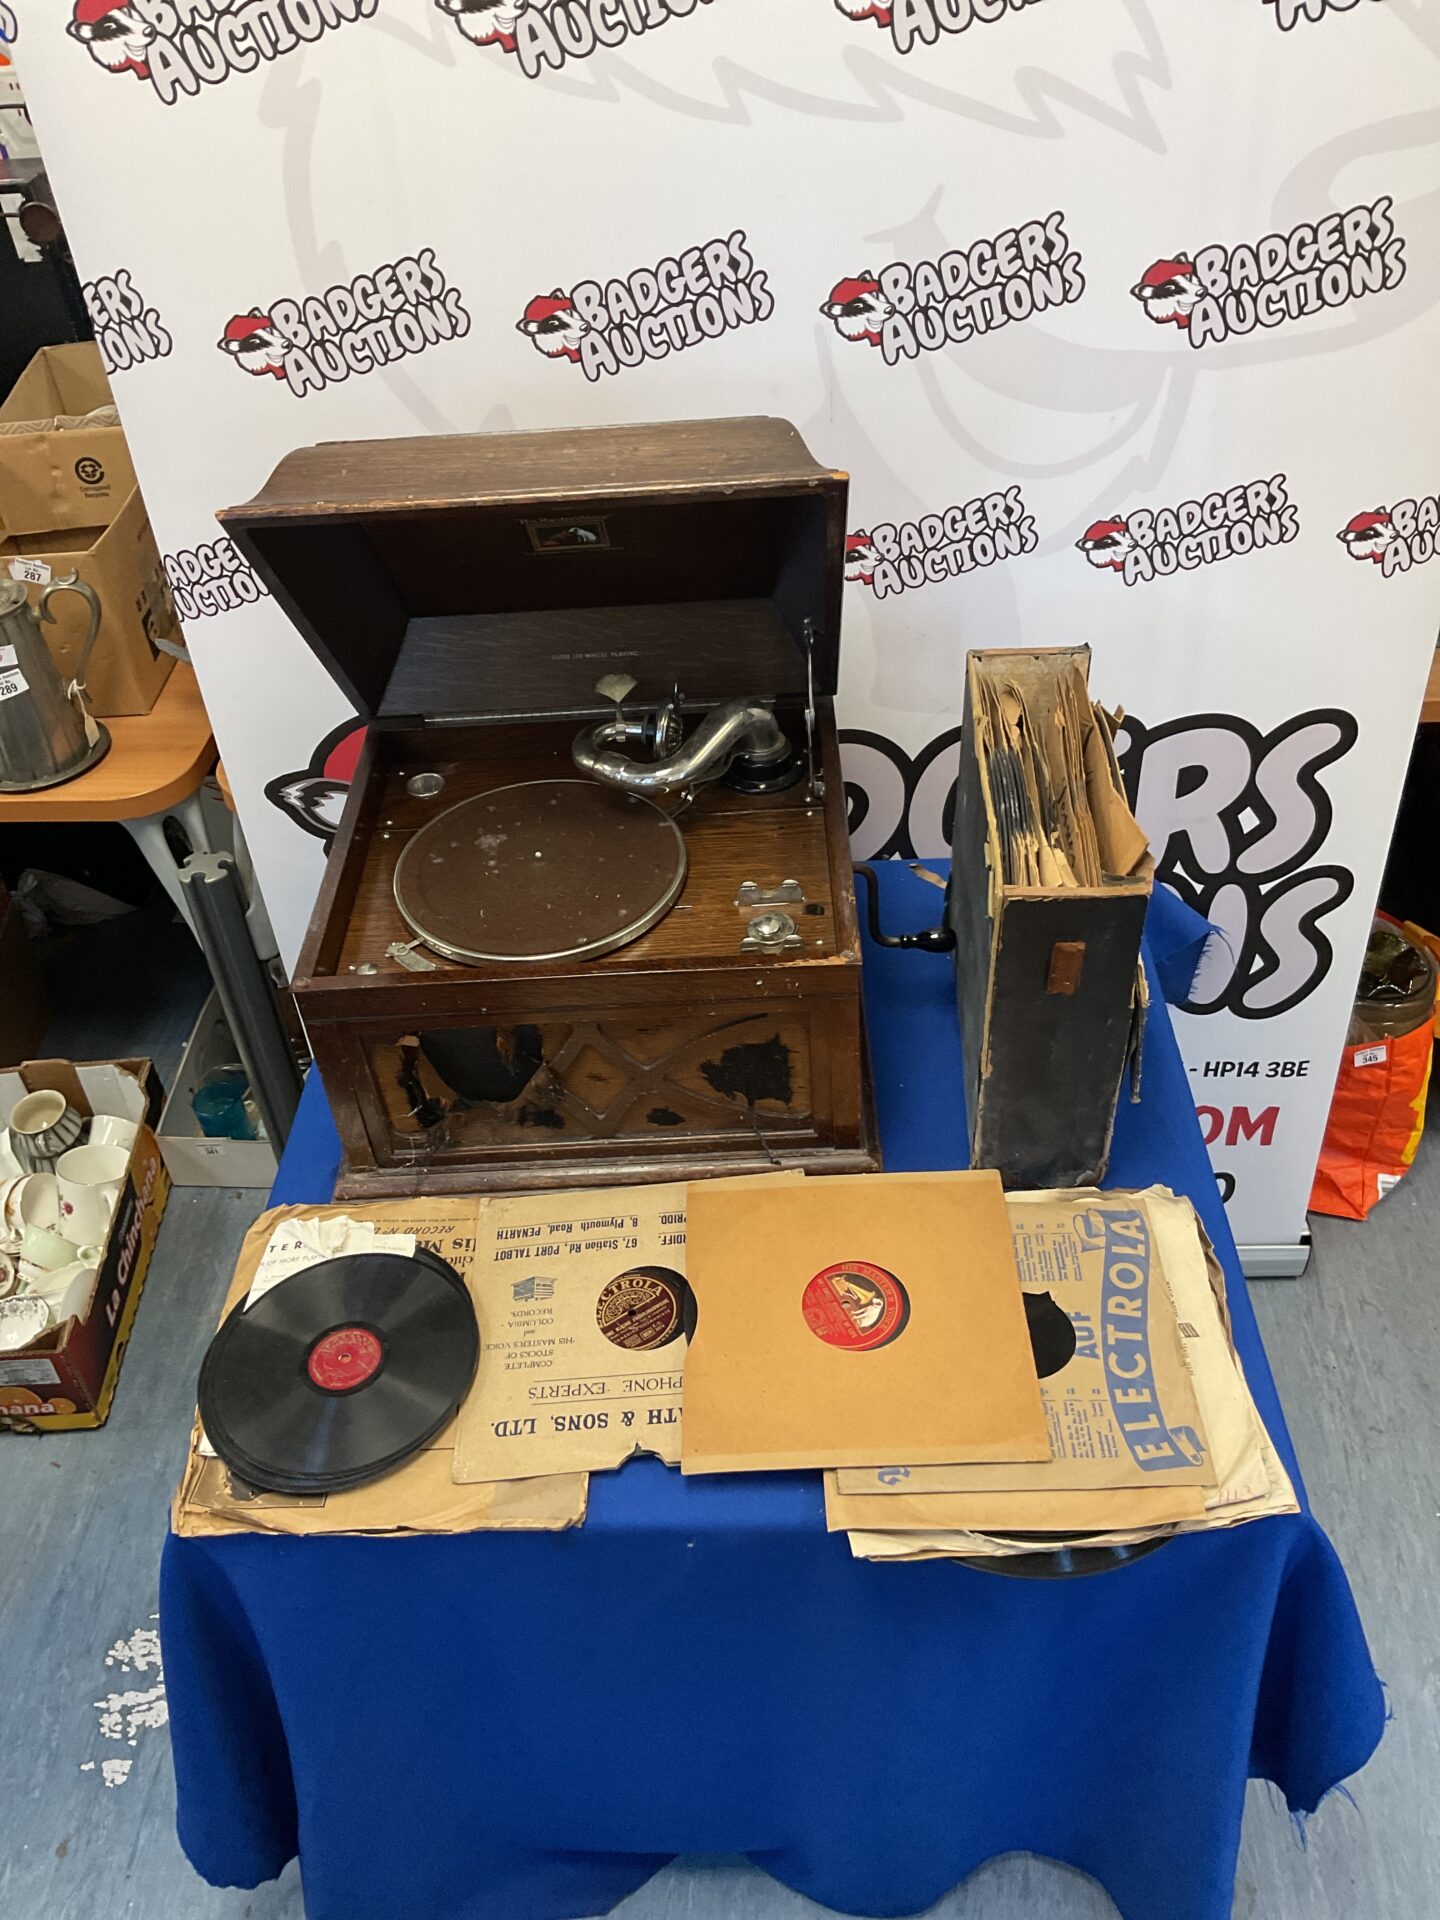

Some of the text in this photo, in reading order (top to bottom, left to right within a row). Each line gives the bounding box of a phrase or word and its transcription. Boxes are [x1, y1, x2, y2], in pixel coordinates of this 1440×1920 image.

[1194, 195, 1394, 298] BADGERS
[878, 211, 1068, 316] BADGERS
[570, 230, 753, 332] BADGERS
[268, 248, 445, 350] BADGERS
[1188, 237, 1406, 349] AUCTIONS
[881, 251, 1085, 366] AUCTIONS
[581, 270, 774, 382] AUCTIONS
[285, 288, 470, 398] AUCTIONS
[1126, 473, 1288, 550] BADGERS
[870, 484, 1024, 563] BADGERS
[1122, 504, 1299, 587] AUCTIONS
[872, 515, 1039, 600] AUCTIONS
[24, 570, 42, 582] 287
[0, 683, 18, 696] 289
[1203, 1061, 1260, 1078] HP14
[1265, 1060, 1310, 1078] 3BE
[1362, 1054, 1378, 1065] 345
[405, 1225, 455, 1235] RECORD
[497, 1226, 541, 1240] PENARTH
[581, 1215, 624, 1232] Plymouth
[494, 1247, 531, 1262] TALBOT
[534, 1244, 560, 1257] PORT
[585, 1238, 619, 1252] Station
[508, 1318, 553, 1328] COLUMBIA
[523, 1329, 536, 1337] and
[1068, 1311, 1100, 1360] AUF
[1107, 1216, 1175, 1461] ELECTROLA
[504, 1349, 553, 1359] STOCKS OF
[504, 1360, 553, 1370] COMPLETE
[528, 1381, 606, 1400] EXPERTS
[491, 1418, 537, 1437] LTD.
[551, 1412, 609, 1431] SONS,
[621, 1411, 635, 1426] &
